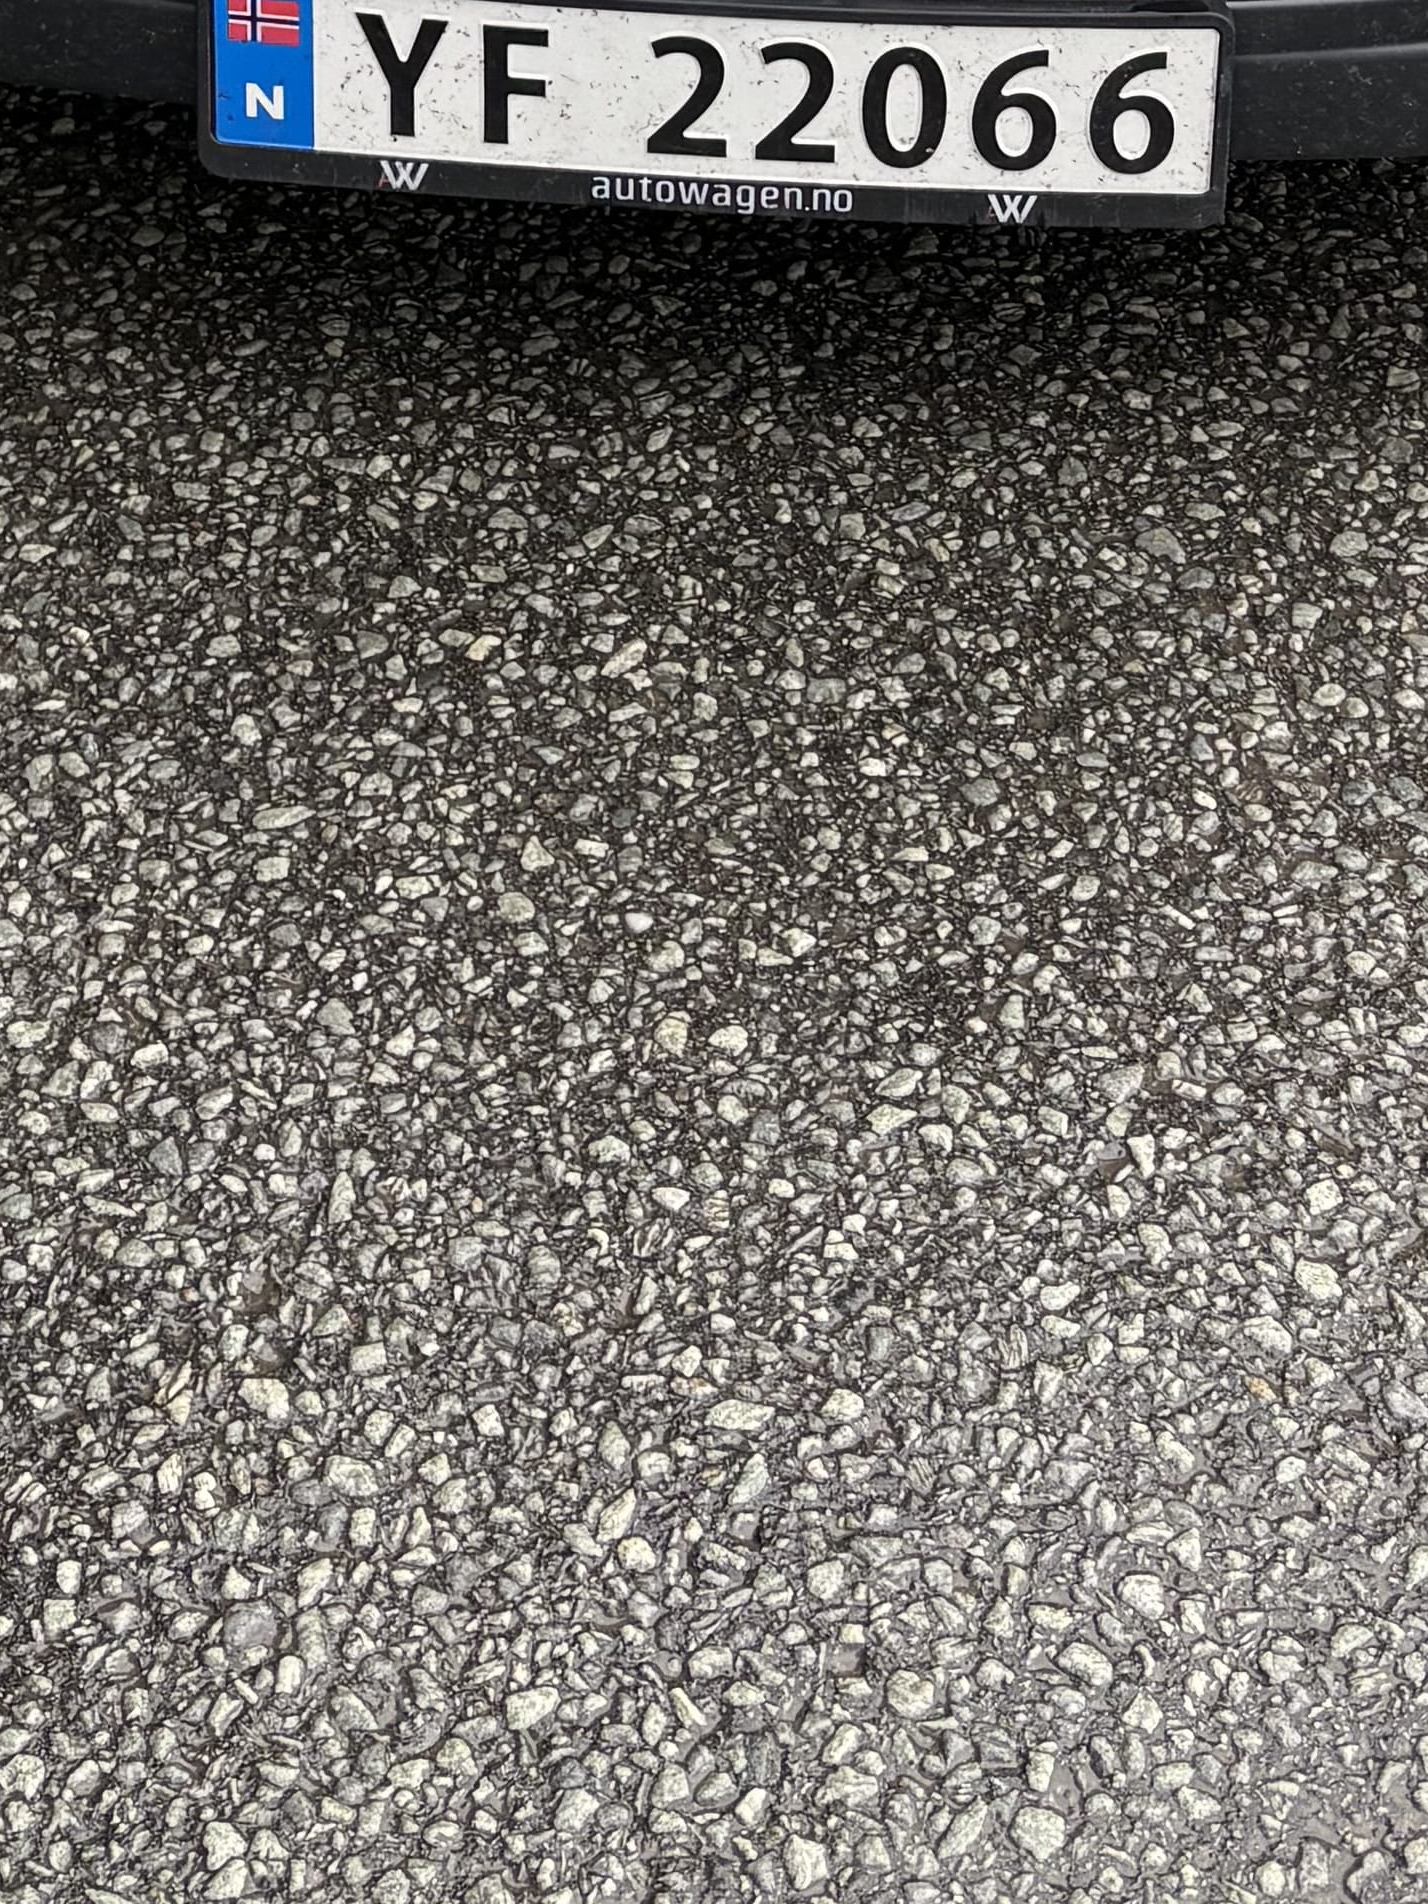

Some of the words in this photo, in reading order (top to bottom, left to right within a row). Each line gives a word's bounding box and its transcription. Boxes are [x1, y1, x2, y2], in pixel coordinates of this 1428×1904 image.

[245, 82, 285, 121] N
[354, 11, 550, 145] YF
[645, 34, 1174, 175] 22066
[590, 175, 854, 214] autowagen.no
